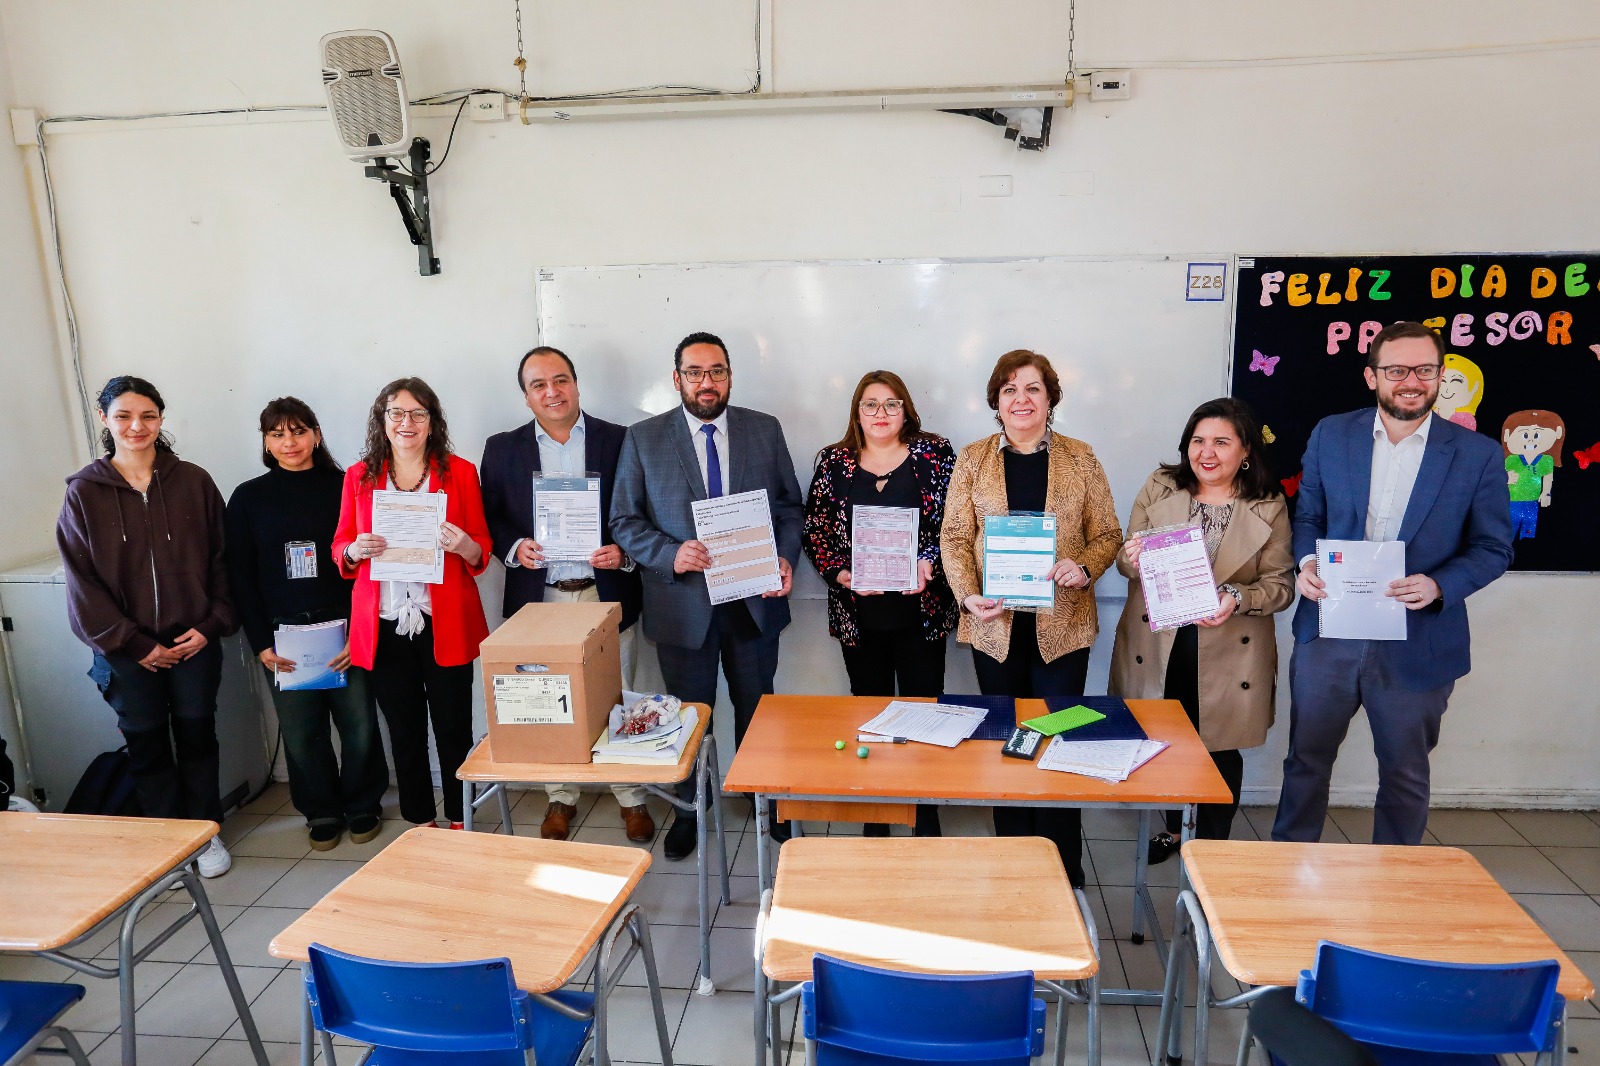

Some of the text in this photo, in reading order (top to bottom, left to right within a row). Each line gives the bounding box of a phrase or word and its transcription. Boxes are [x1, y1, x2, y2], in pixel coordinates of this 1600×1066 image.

[1189, 275, 1223, 289] Z28
[1260, 263, 1600, 306] FELIZ DIA DE
[1326, 311, 1573, 355] PRESOR
[557, 694, 568, 713] 1
